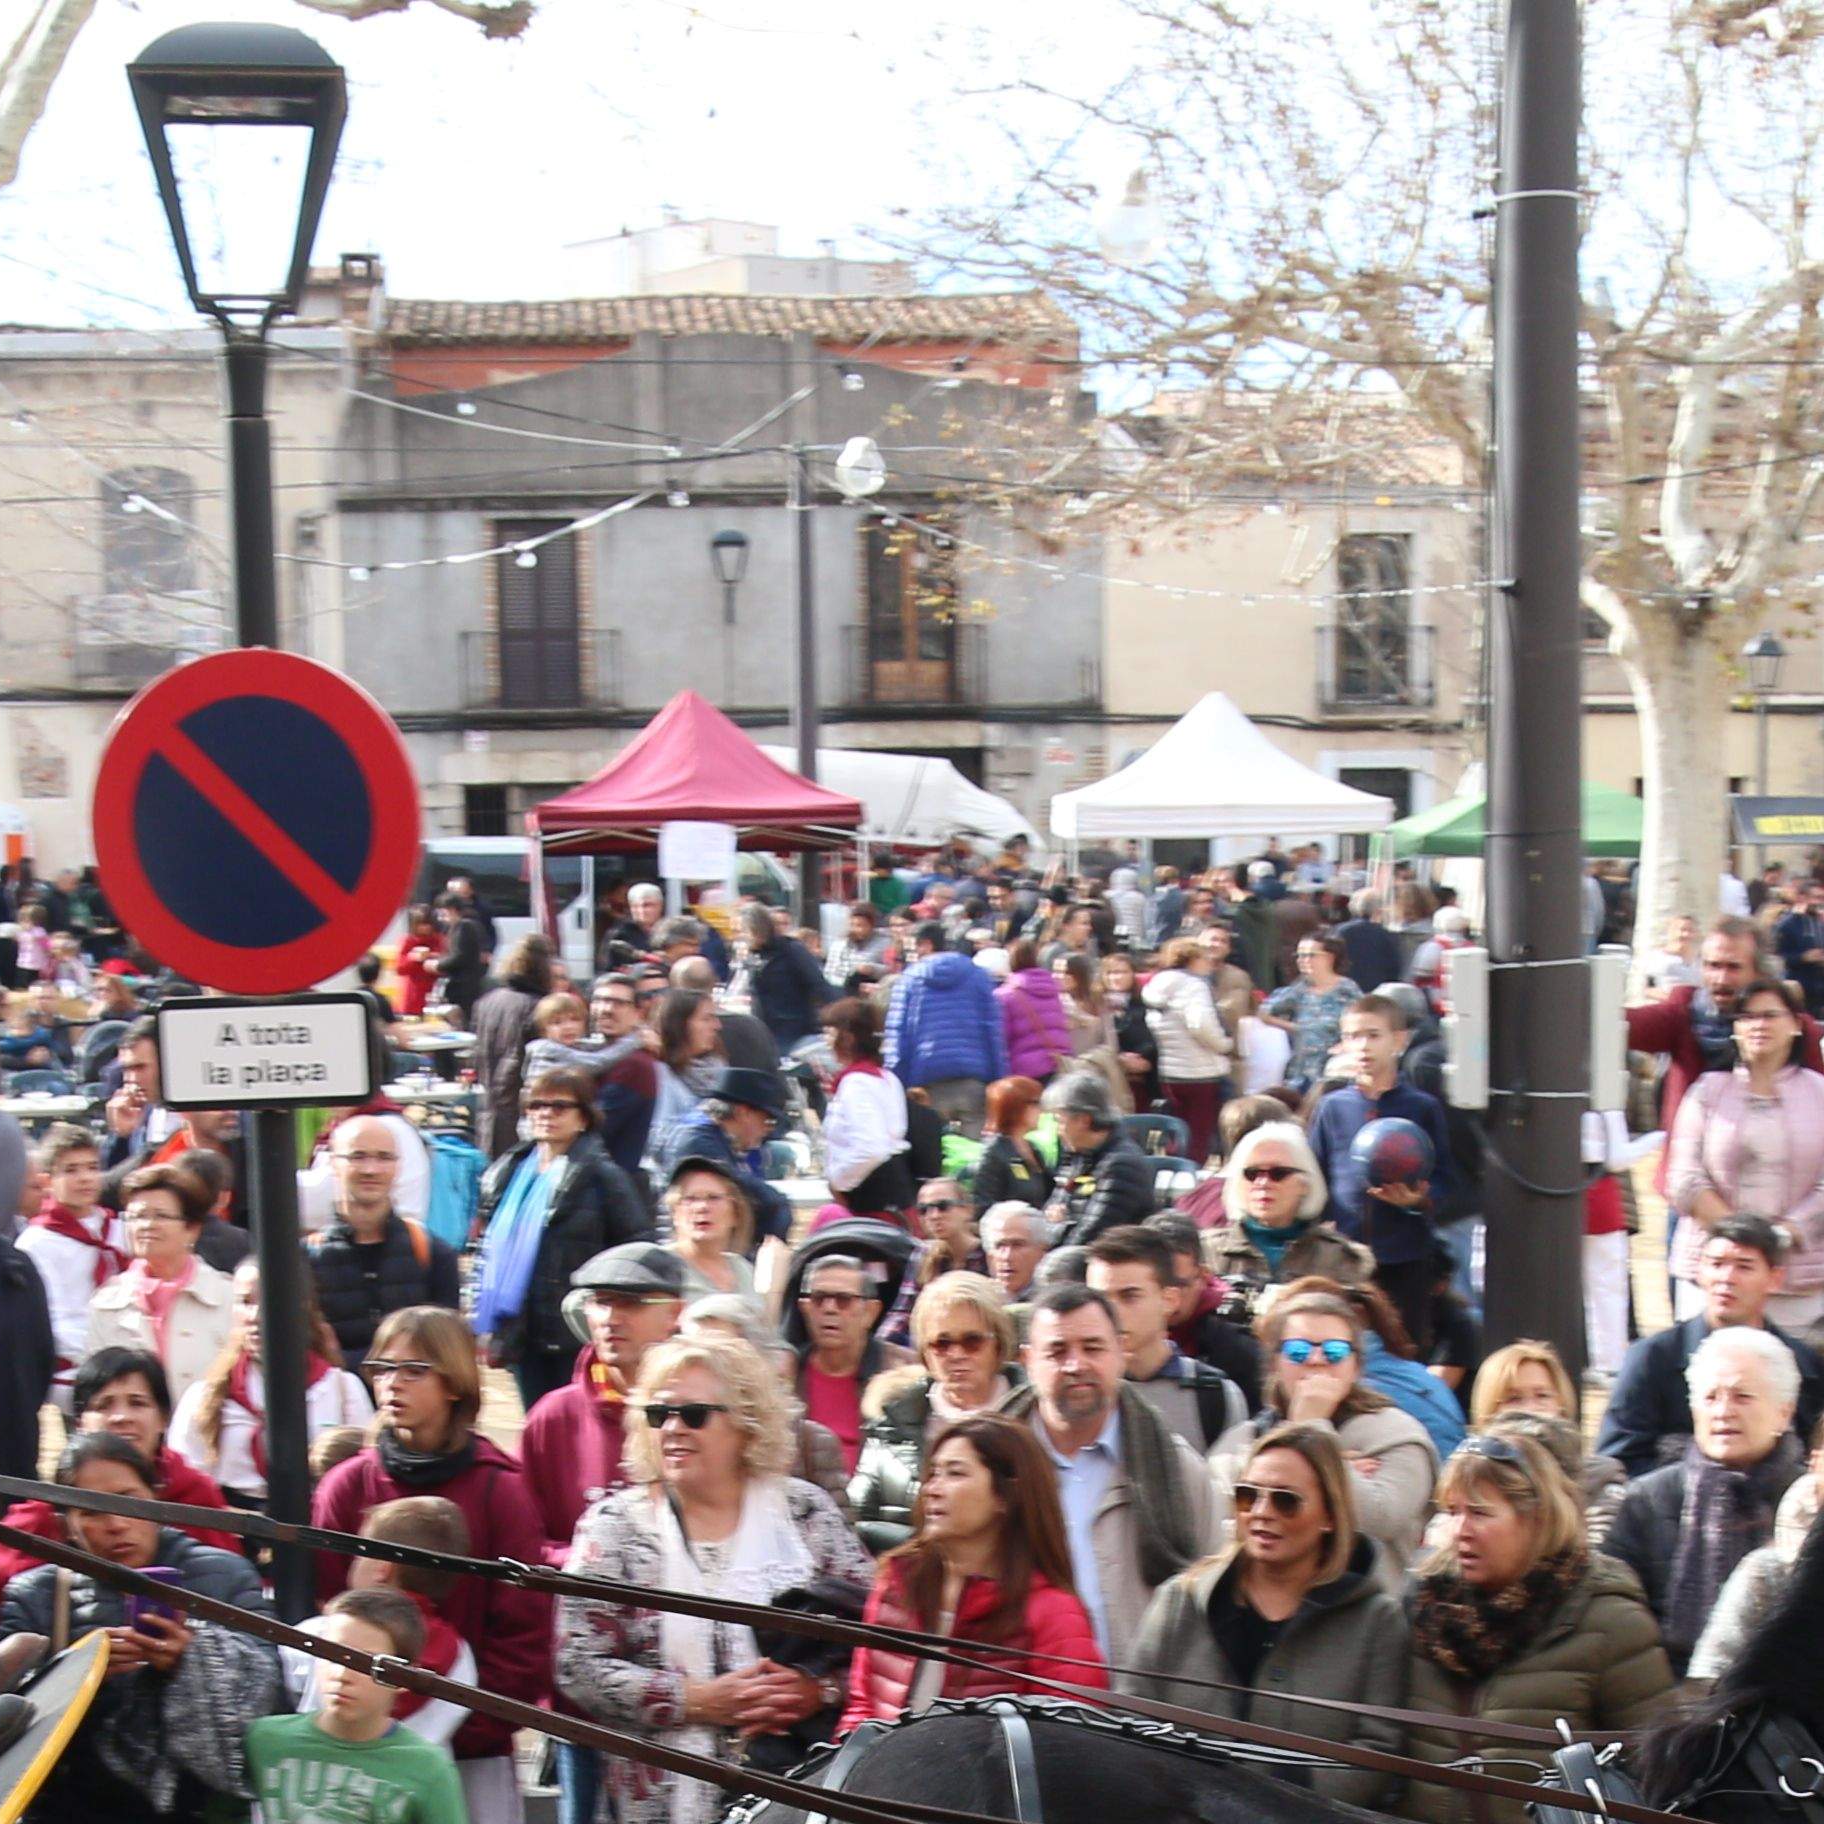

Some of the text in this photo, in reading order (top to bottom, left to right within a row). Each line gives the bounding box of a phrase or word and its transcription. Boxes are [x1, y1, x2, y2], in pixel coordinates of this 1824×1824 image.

[214, 1021, 312, 1046] A tota
[201, 1058, 328, 1090] la plaça
